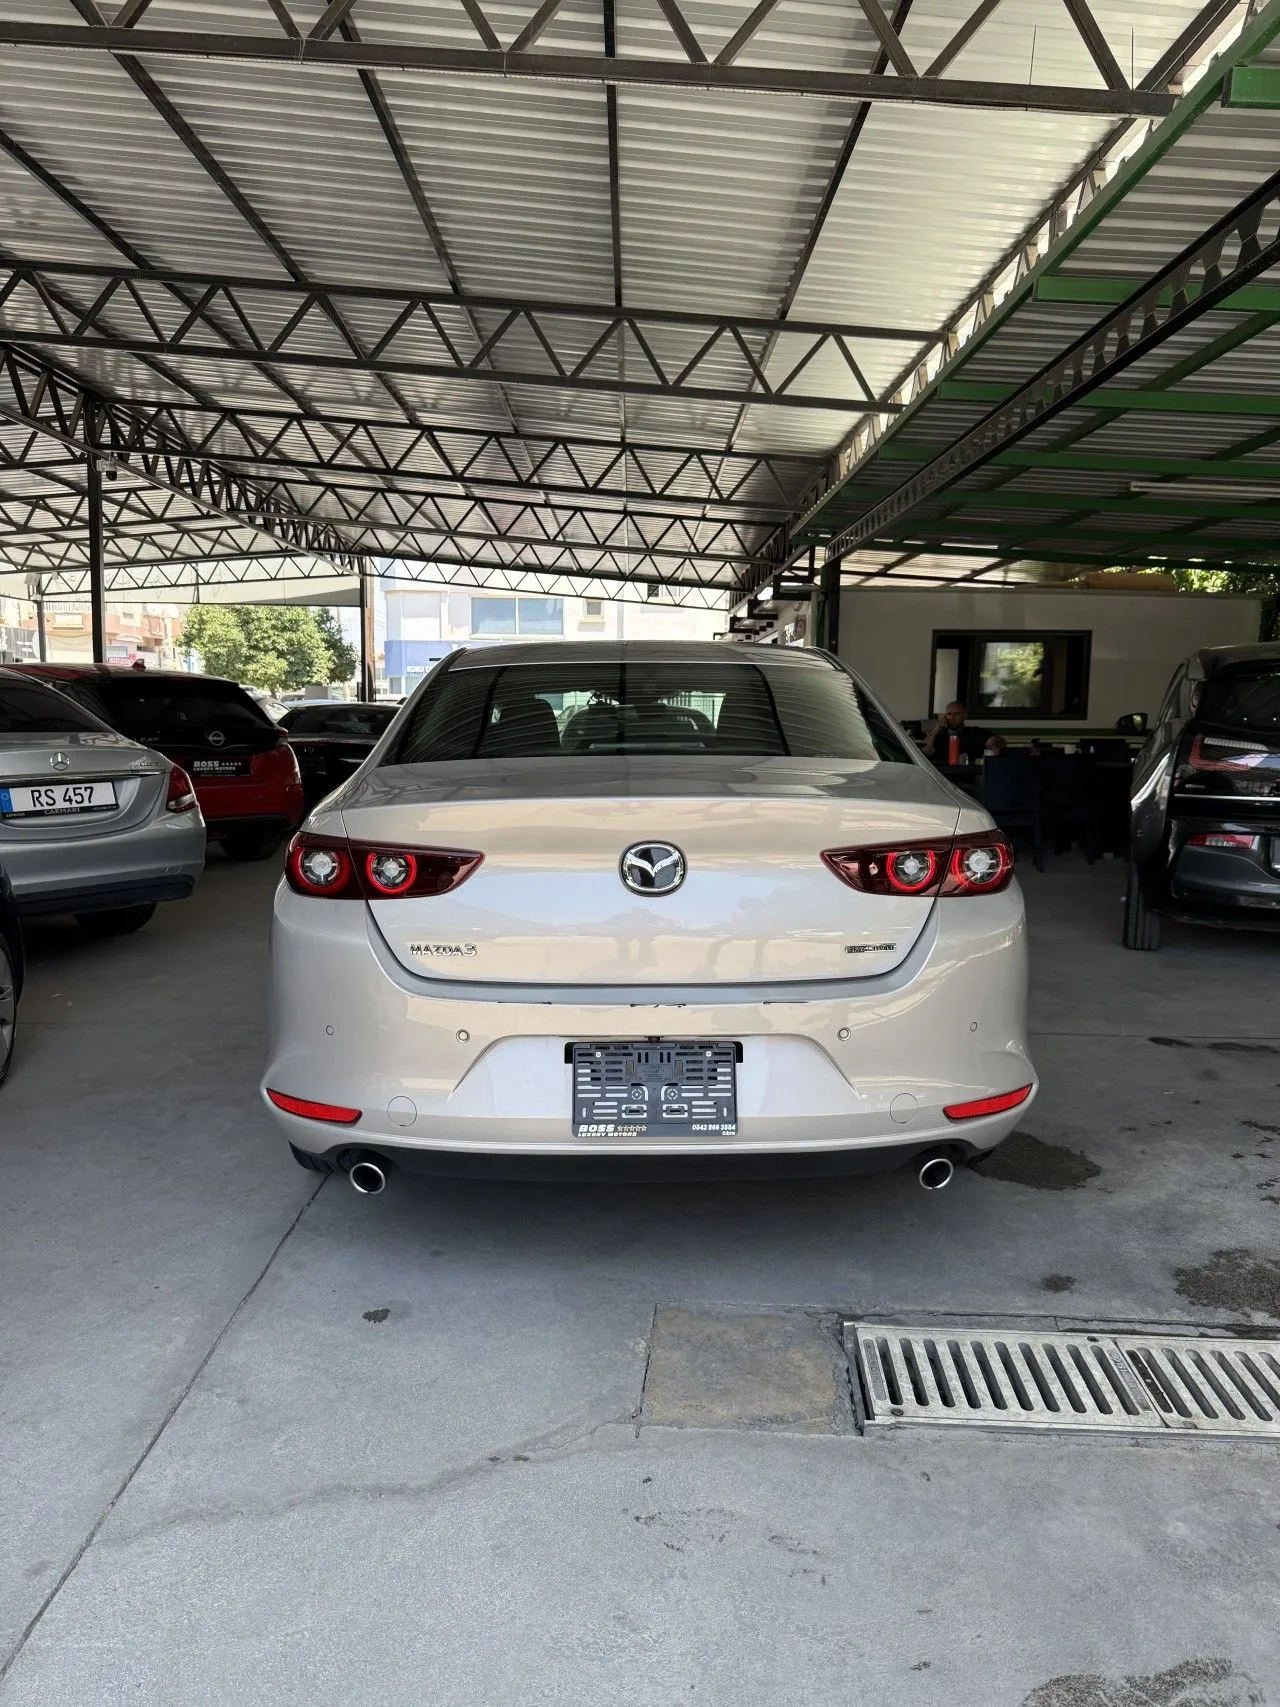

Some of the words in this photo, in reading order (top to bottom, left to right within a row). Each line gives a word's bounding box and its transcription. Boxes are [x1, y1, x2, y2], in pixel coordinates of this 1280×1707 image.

[193, 760, 220, 768] BOSS
[30, 789, 56, 808] RS
[62, 786, 94, 805] 457
[410, 943, 478, 957] MAZDA3
[578, 1124, 615, 1132] BOSS
